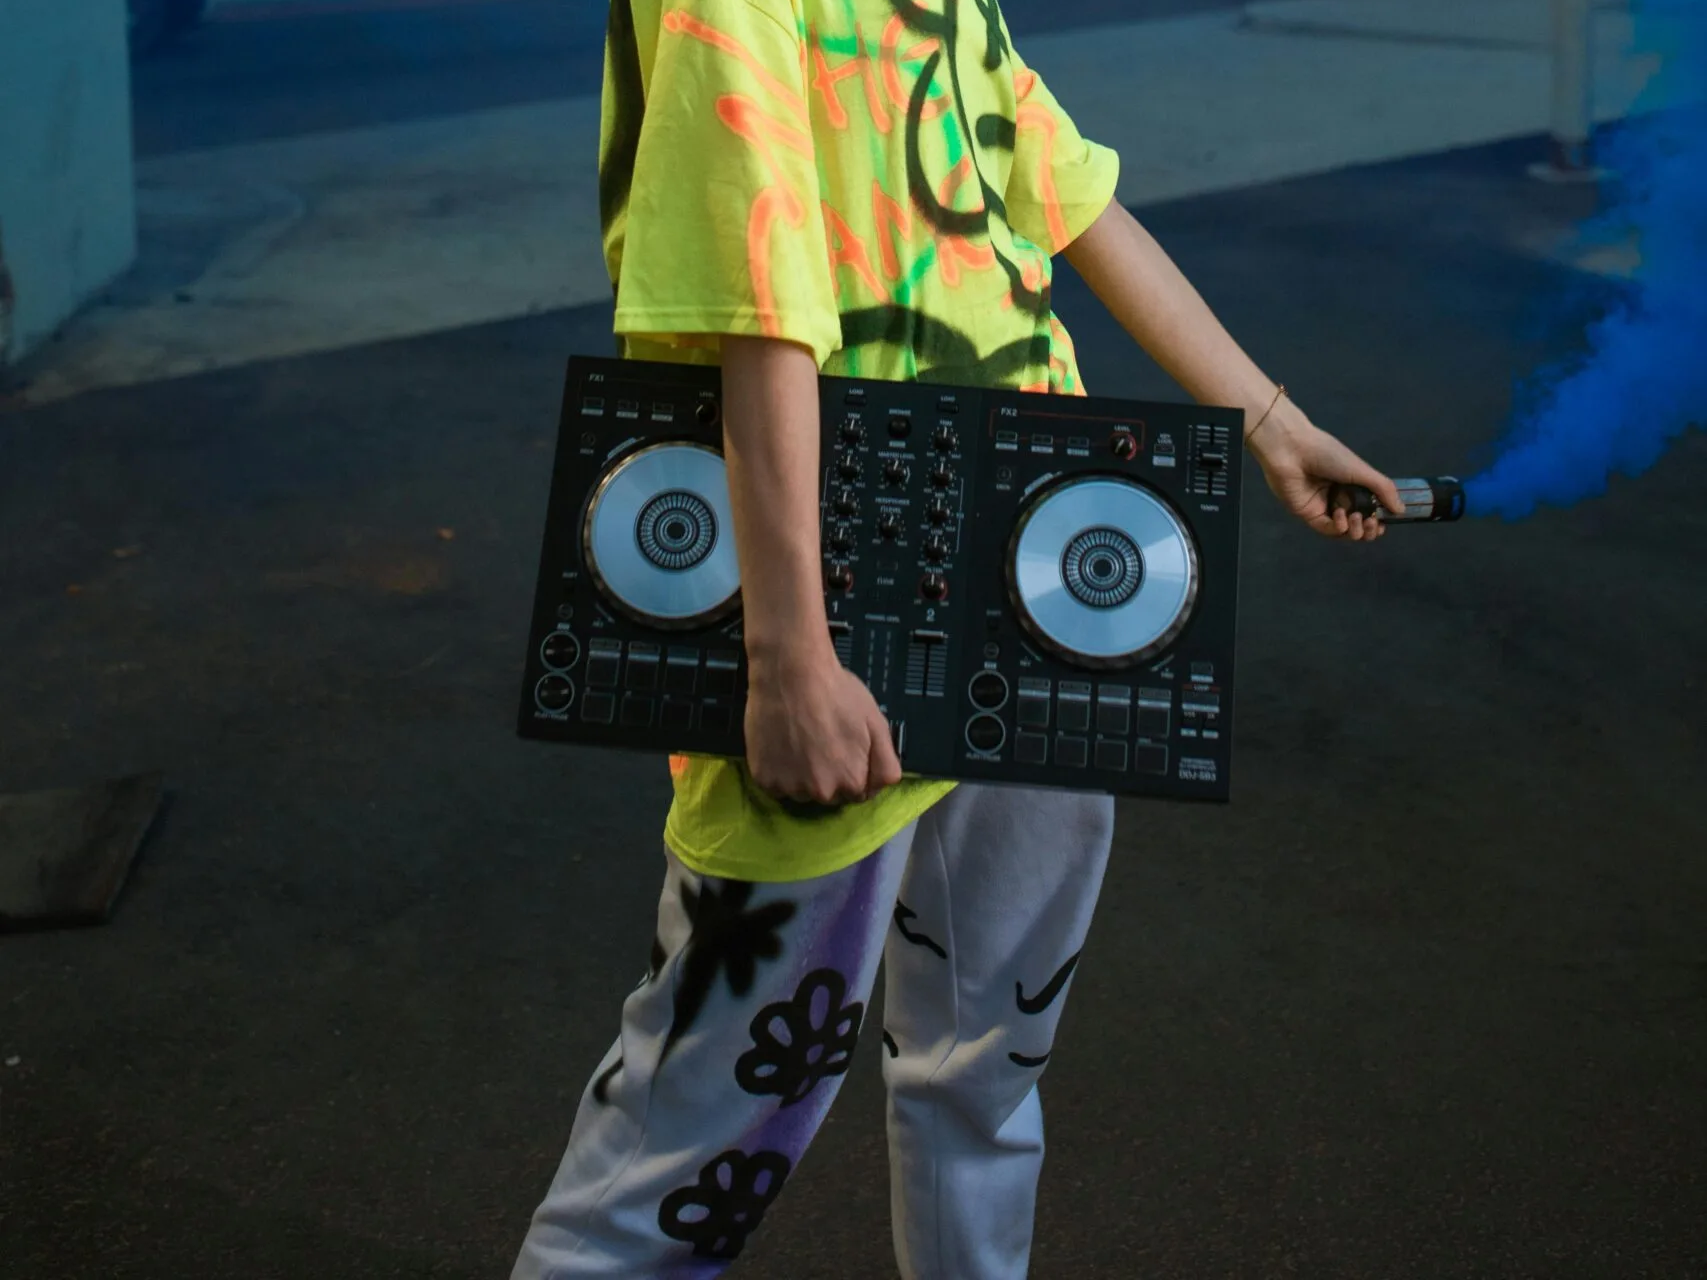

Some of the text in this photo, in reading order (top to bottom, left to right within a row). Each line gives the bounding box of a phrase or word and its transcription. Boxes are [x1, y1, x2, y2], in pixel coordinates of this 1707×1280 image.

[1001, 407, 1018, 417] FX2
[832, 600, 838, 613] 1
[926, 607, 935, 622] 2
